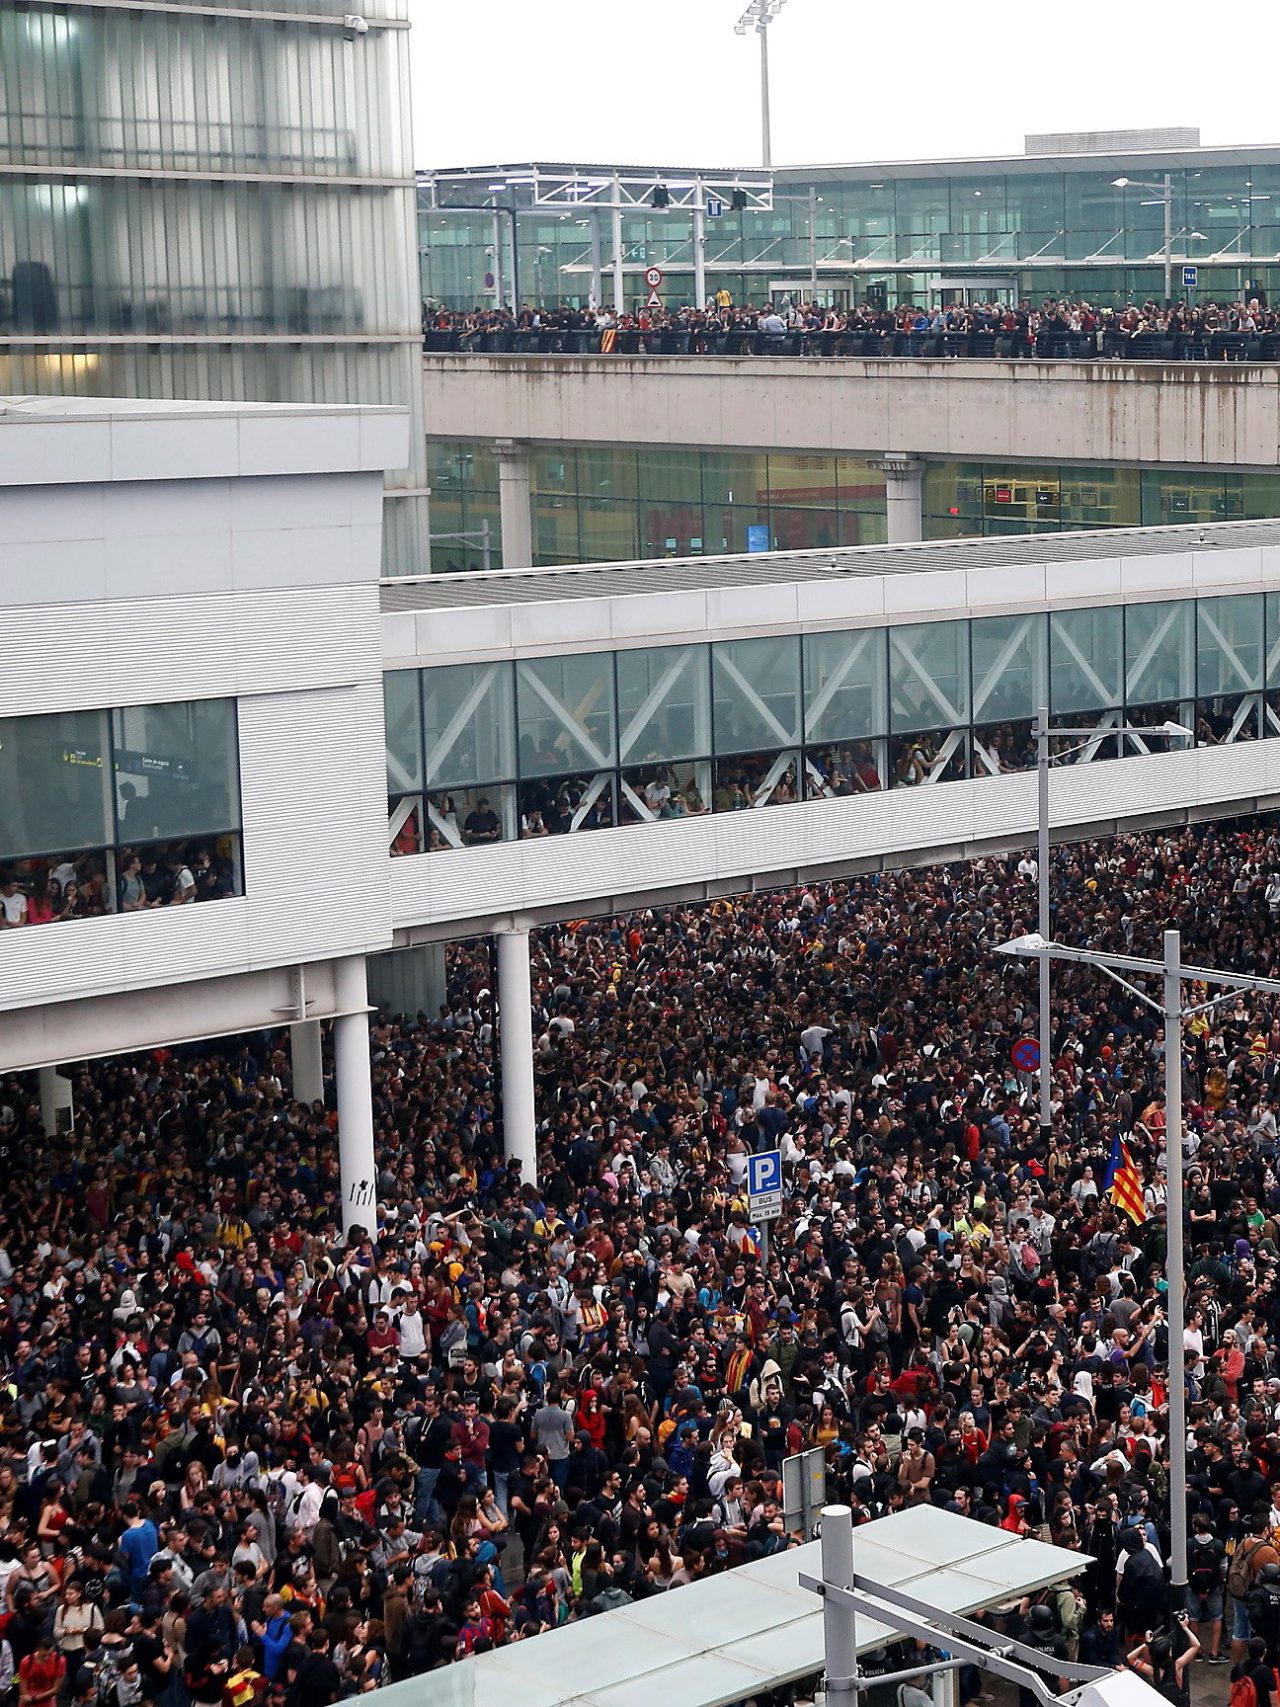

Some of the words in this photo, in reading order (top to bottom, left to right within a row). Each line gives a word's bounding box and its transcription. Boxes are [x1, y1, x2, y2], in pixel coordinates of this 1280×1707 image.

[649, 273, 658, 281] 30
[755, 1157, 775, 1191] P
[758, 1195, 773, 1205] BUS
[865, 1668, 885, 1676] POLICIA
